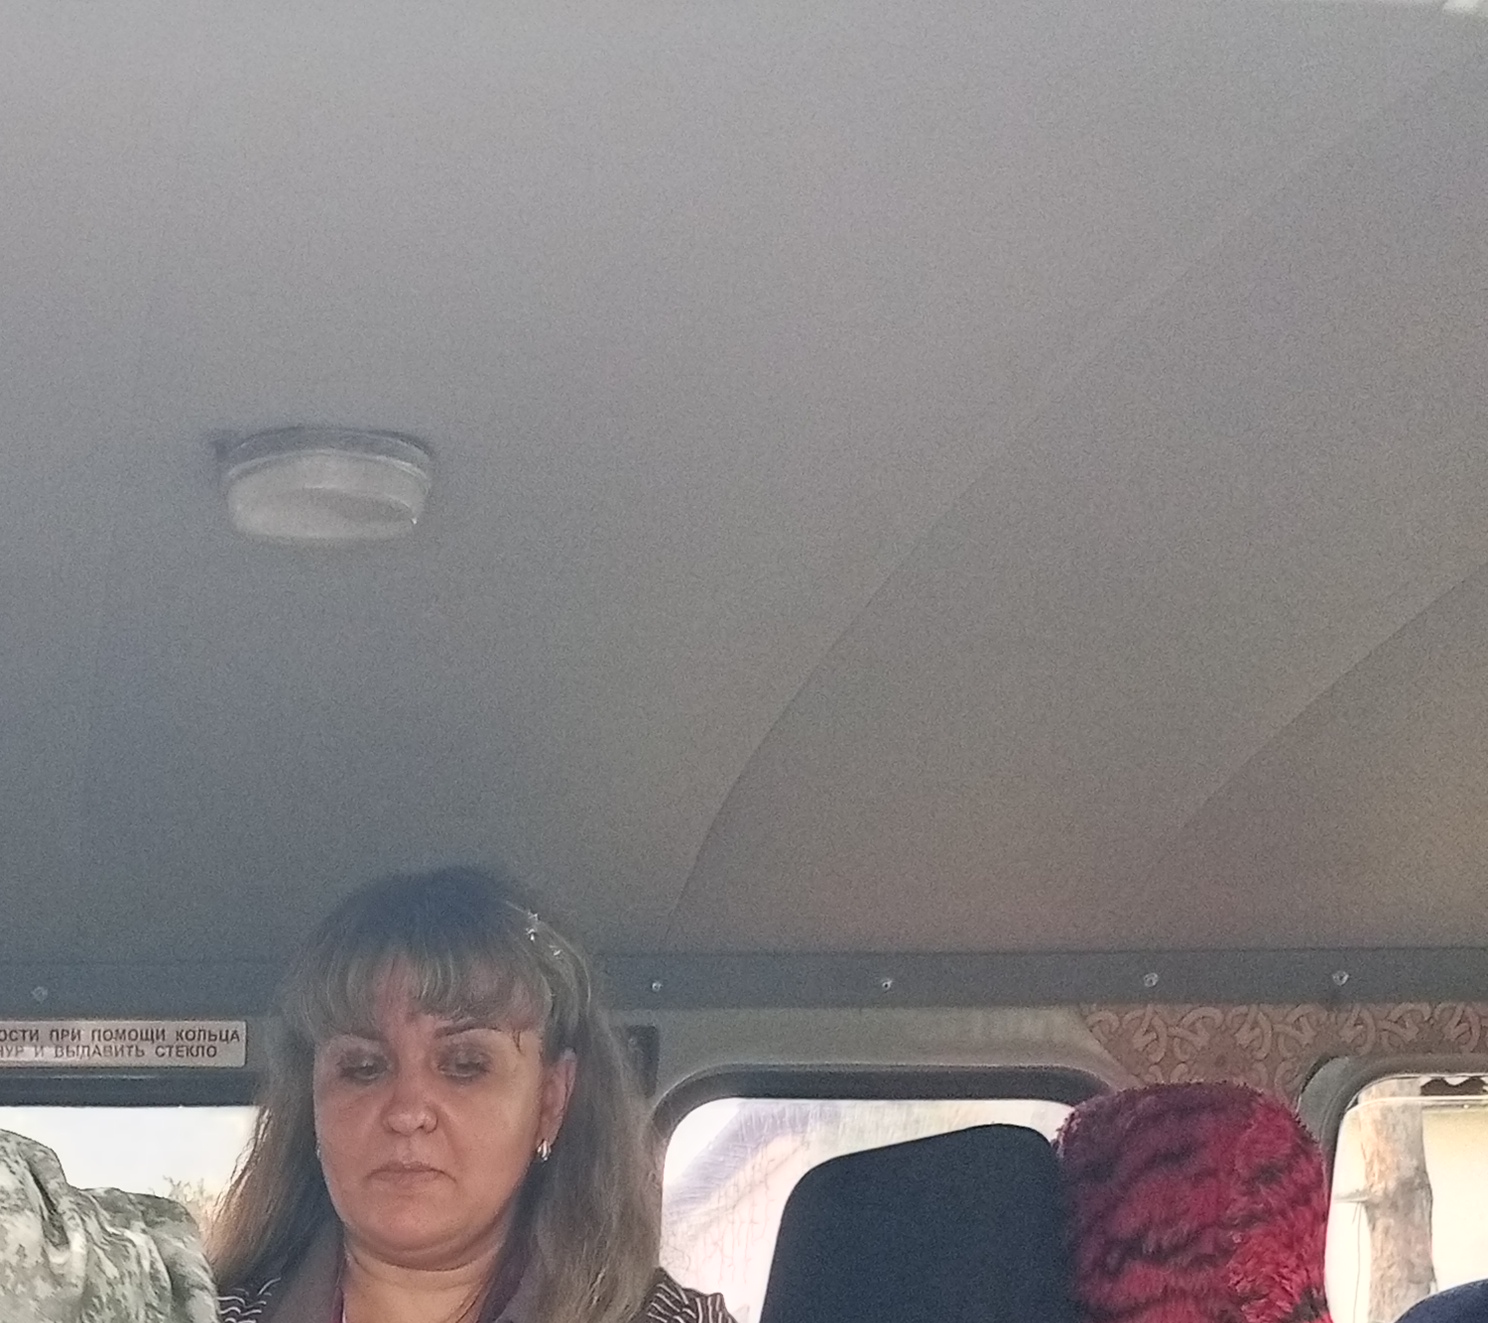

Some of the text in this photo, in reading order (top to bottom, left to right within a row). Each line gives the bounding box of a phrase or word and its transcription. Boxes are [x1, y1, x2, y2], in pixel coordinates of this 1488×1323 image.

[49, 1028, 81, 1042] ПРИ
[91, 1028, 166, 1044] ПОМОЩИ
[175, 1028, 240, 1044] КОЛЬЦА
[33, 1045, 45, 1058] И
[54, 1045, 145, 1059] ВЫДАВИТЬ
[155, 1045, 218, 1058] СТЕКЛО
